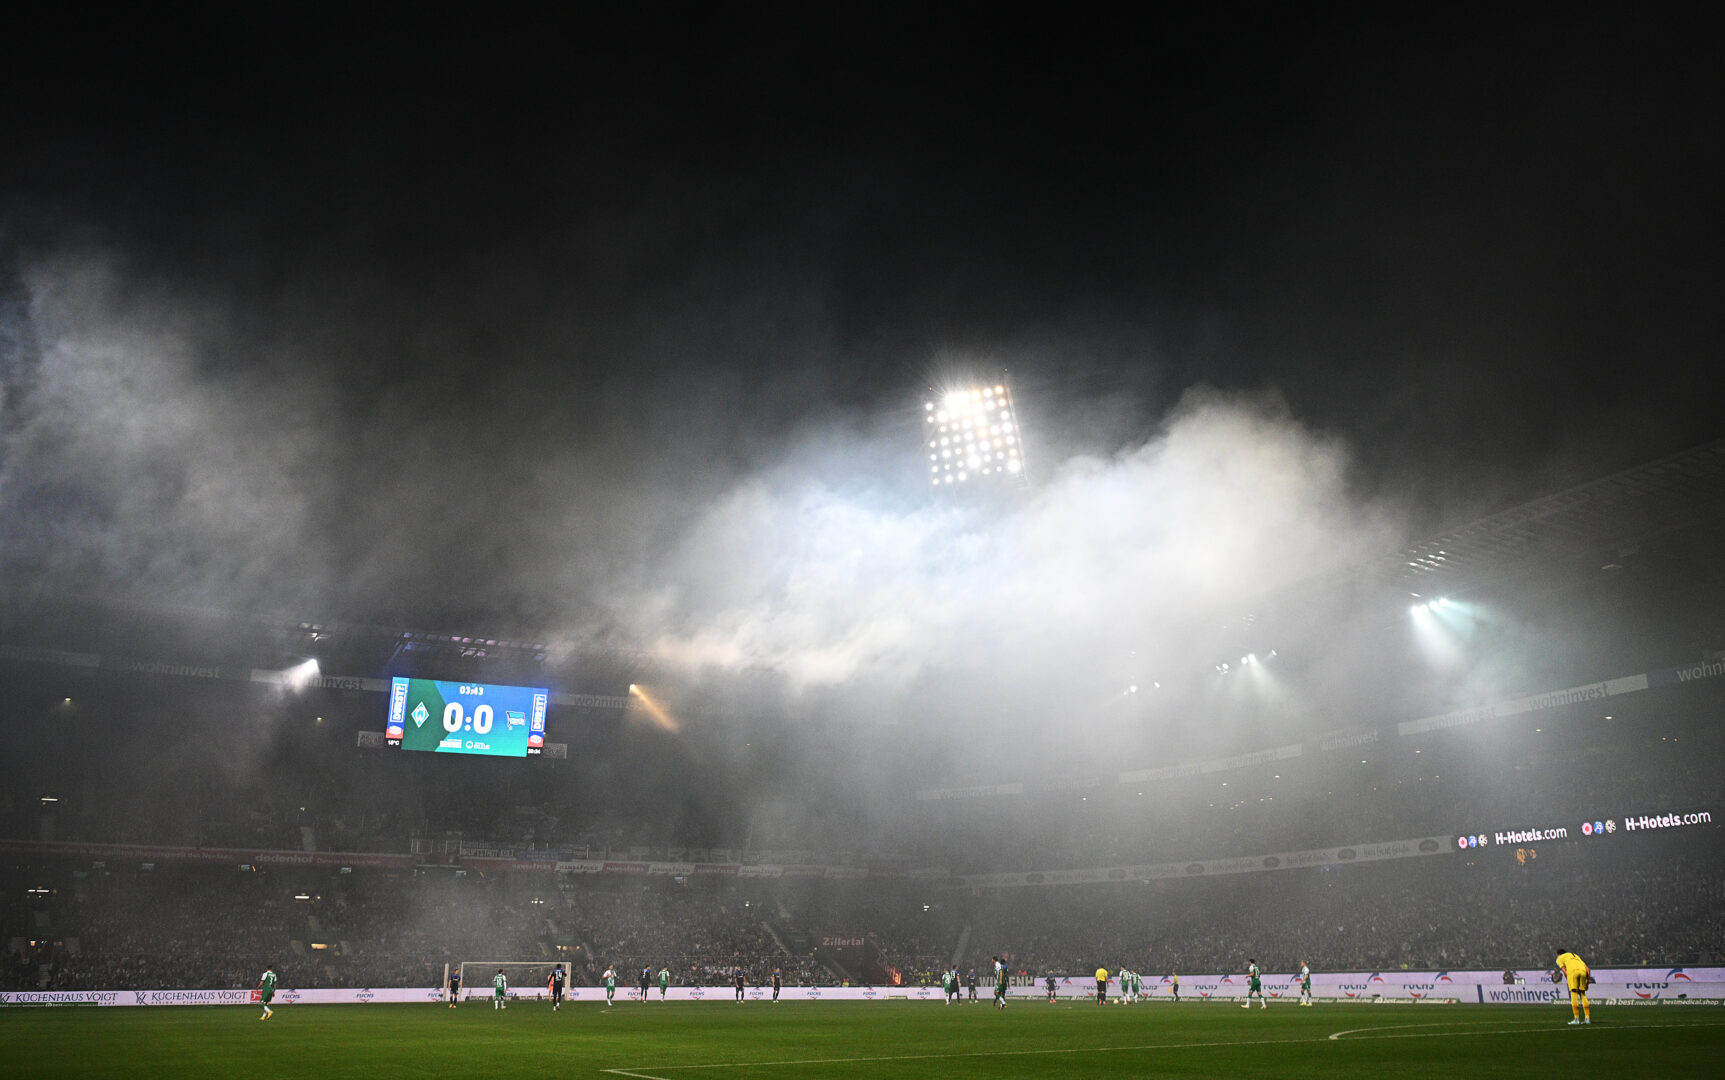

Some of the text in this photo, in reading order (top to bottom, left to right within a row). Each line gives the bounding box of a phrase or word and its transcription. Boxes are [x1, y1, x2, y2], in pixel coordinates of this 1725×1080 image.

[459, 685, 484, 696] 03:43
[1529, 682, 1609, 712] wohninvest
[442, 702, 494, 734] 0:0
[1625, 811, 1712, 831] H-Hotels.com
[1495, 826, 1567, 845] H-Hotels.com
[255, 854, 314, 864] dodenhof
[822, 936, 865, 946] Zillertal
[16, 993, 84, 1003] KÜCHENHAUS
[86, 992, 118, 1002] VOIGT
[152, 990, 248, 1001] KÜCHENHAUS VOIGT
[1489, 986, 1561, 1001] wohninvest
